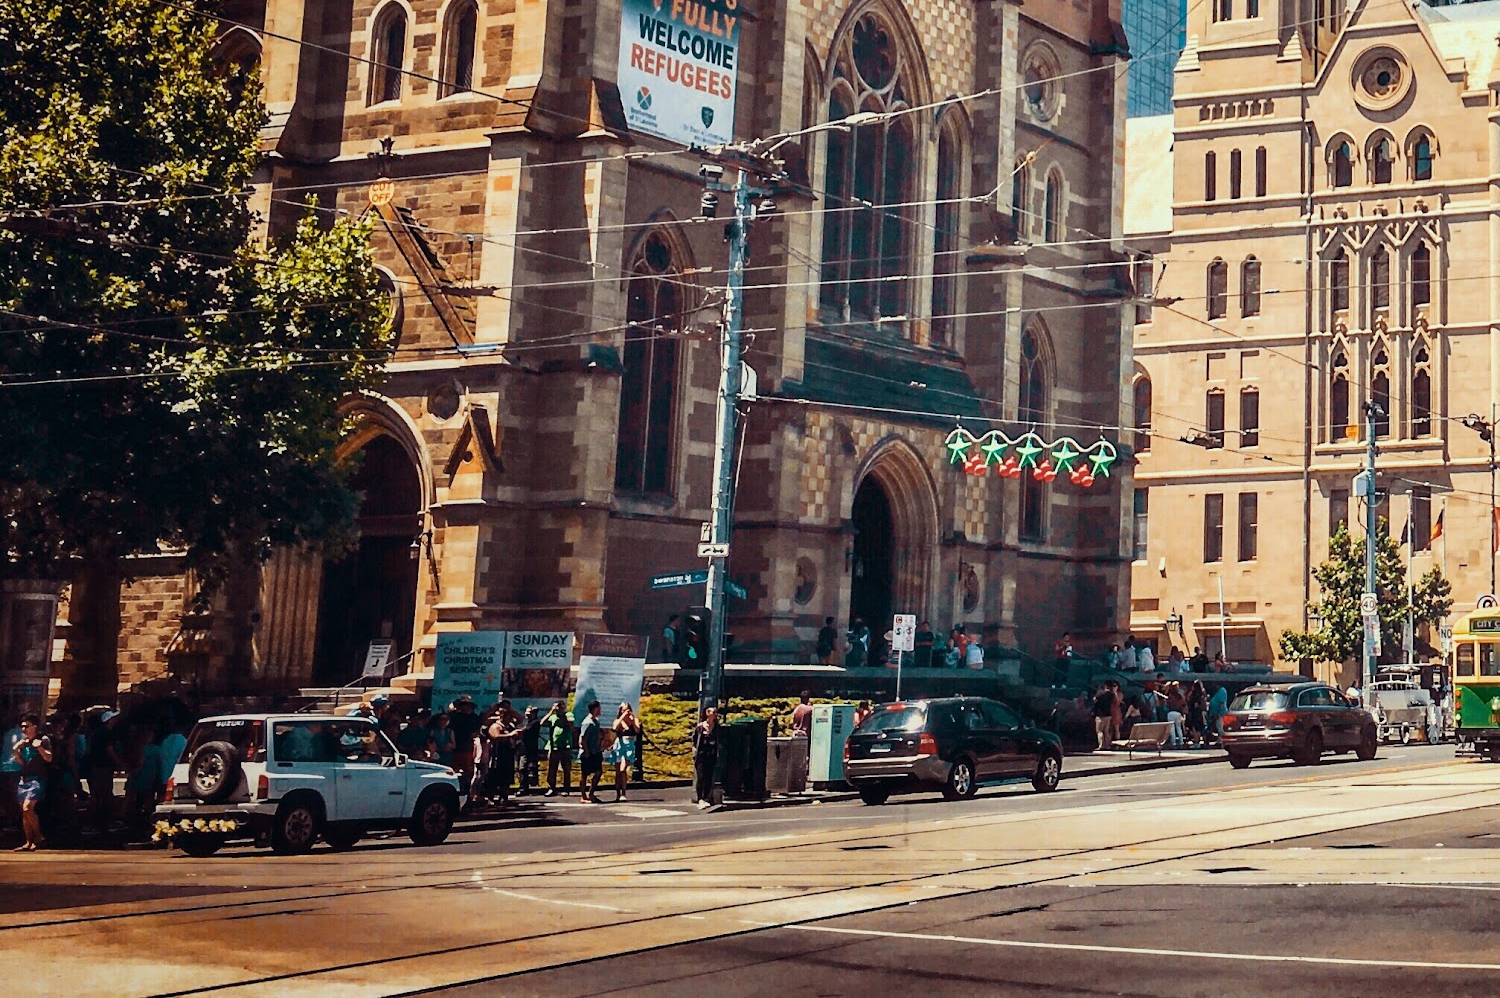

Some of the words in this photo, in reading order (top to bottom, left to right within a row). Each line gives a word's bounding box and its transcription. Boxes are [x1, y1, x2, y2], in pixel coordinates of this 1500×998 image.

[638, 13, 735, 70] WELCOME
[631, 42, 733, 100] REFUGEES
[1364, 600, 1375, 609] 40
[1476, 620, 1492, 628] CITY
[1440, 628, 1453, 639] NO
[513, 634, 568, 645] SUNDAY
[443, 646, 496, 655] CHILDREN'S
[512, 648, 567, 658] SERVICES
[443, 656, 494, 664] CHRISTMAS
[450, 666, 487, 674] SERVICE
[216, 720, 244, 728] SUZUKI
